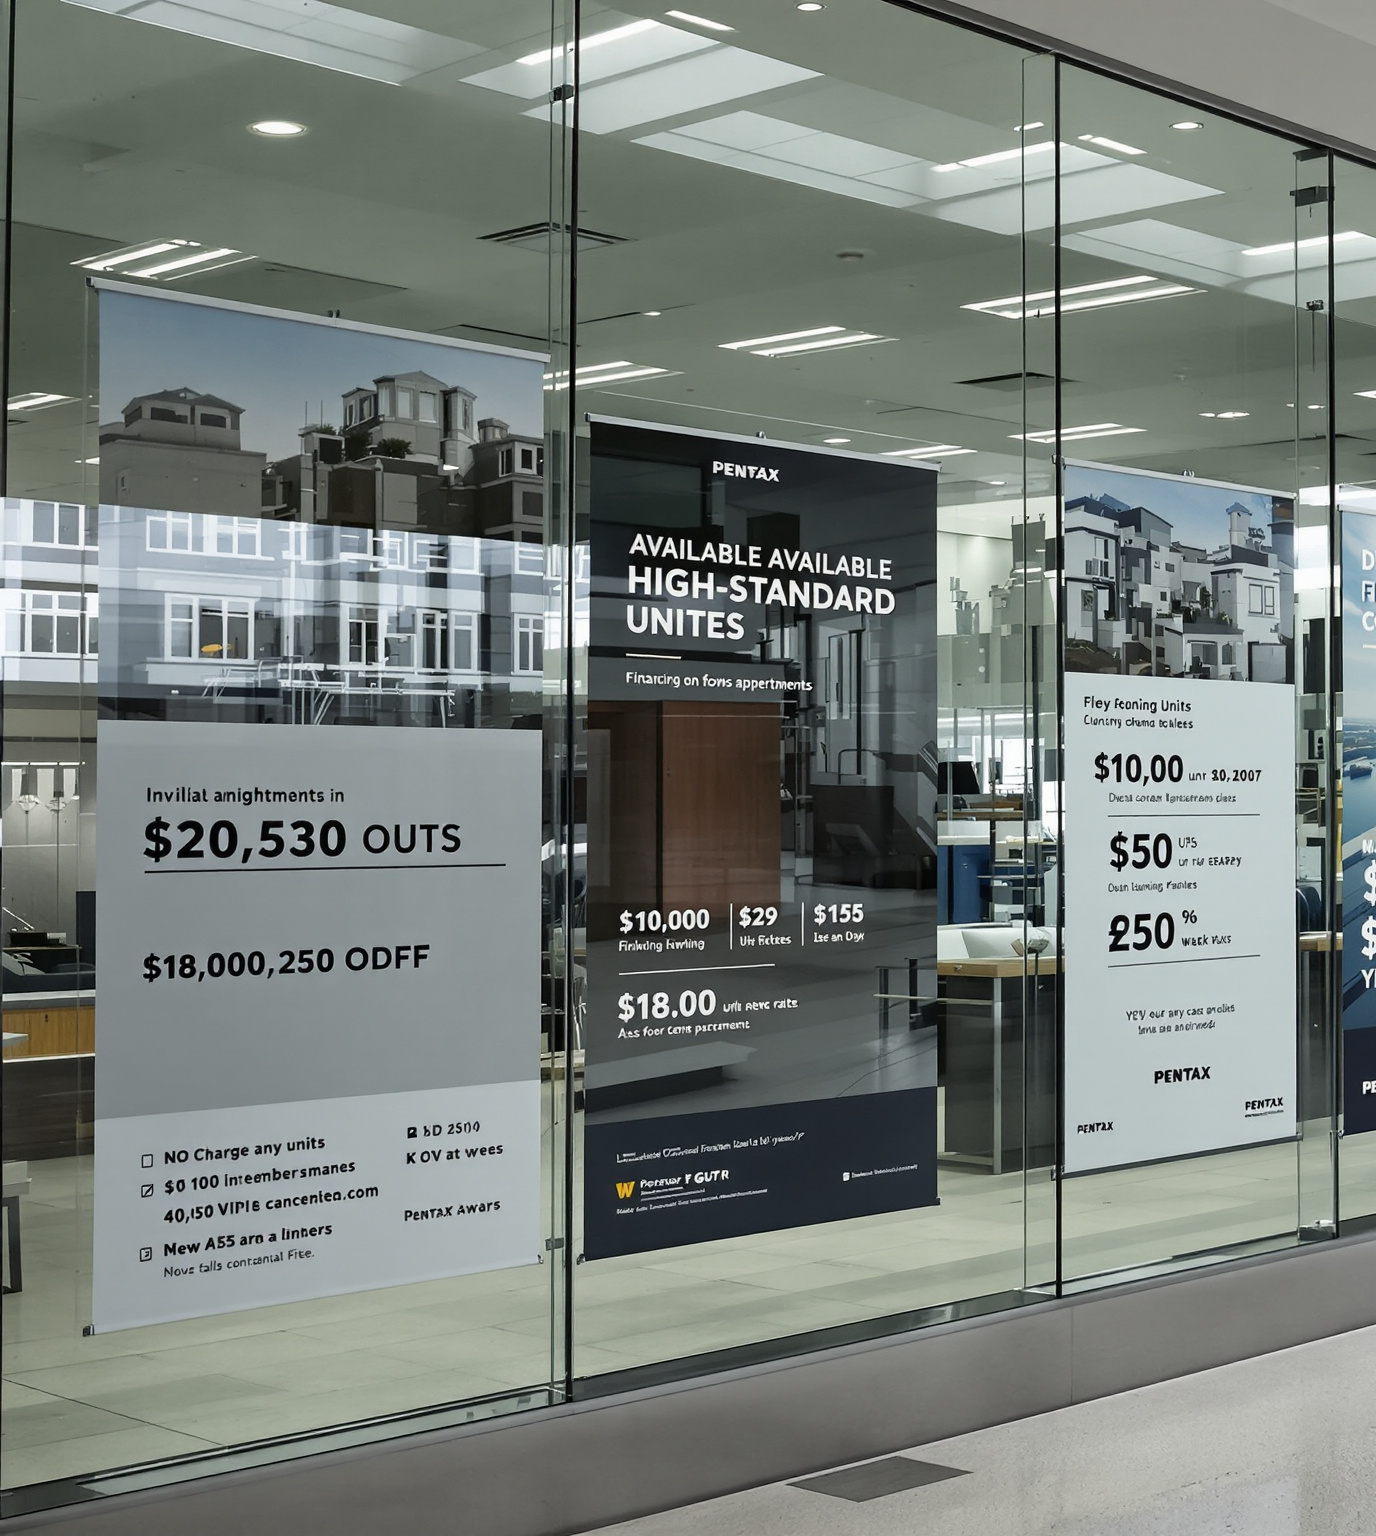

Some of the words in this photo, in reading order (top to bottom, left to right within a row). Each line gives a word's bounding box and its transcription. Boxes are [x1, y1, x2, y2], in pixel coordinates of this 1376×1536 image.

[712, 459, 780, 483] PENTAX
[628, 532, 763, 567] AVAILABLE
[767, 547, 893, 580] AVAILABLE
[627, 564, 896, 615] HIGH-STANDARD
[626, 604, 745, 640] UNITES
[683, 676, 700, 687] on
[1161, 699, 1192, 713] Units
[1094, 751, 1184, 787] $10,00
[330, 787, 345, 803] in
[143, 816, 347, 863] $20,530
[362, 823, 462, 854] OUTS
[1109, 830, 1173, 872] $50
[619, 908, 711, 934] $10,000
[738, 905, 779, 929] $29
[813, 902, 865, 927] $155
[143, 947, 335, 983] $18,000,250
[344, 944, 430, 972] ODFF
[617, 988, 717, 1024] $18.00
[1154, 1066, 1211, 1084] PENTAX
[1244, 1096, 1284, 1111] PENTAX
[164, 1149, 189, 1165] NO
[193, 1145, 249, 1161] Charge
[254, 1142, 282, 1156] any
[286, 1136, 326, 1152] units
[446, 1148, 461, 1161] at
[465, 1144, 504, 1158] wees
[191, 1174, 220, 1191] 100
